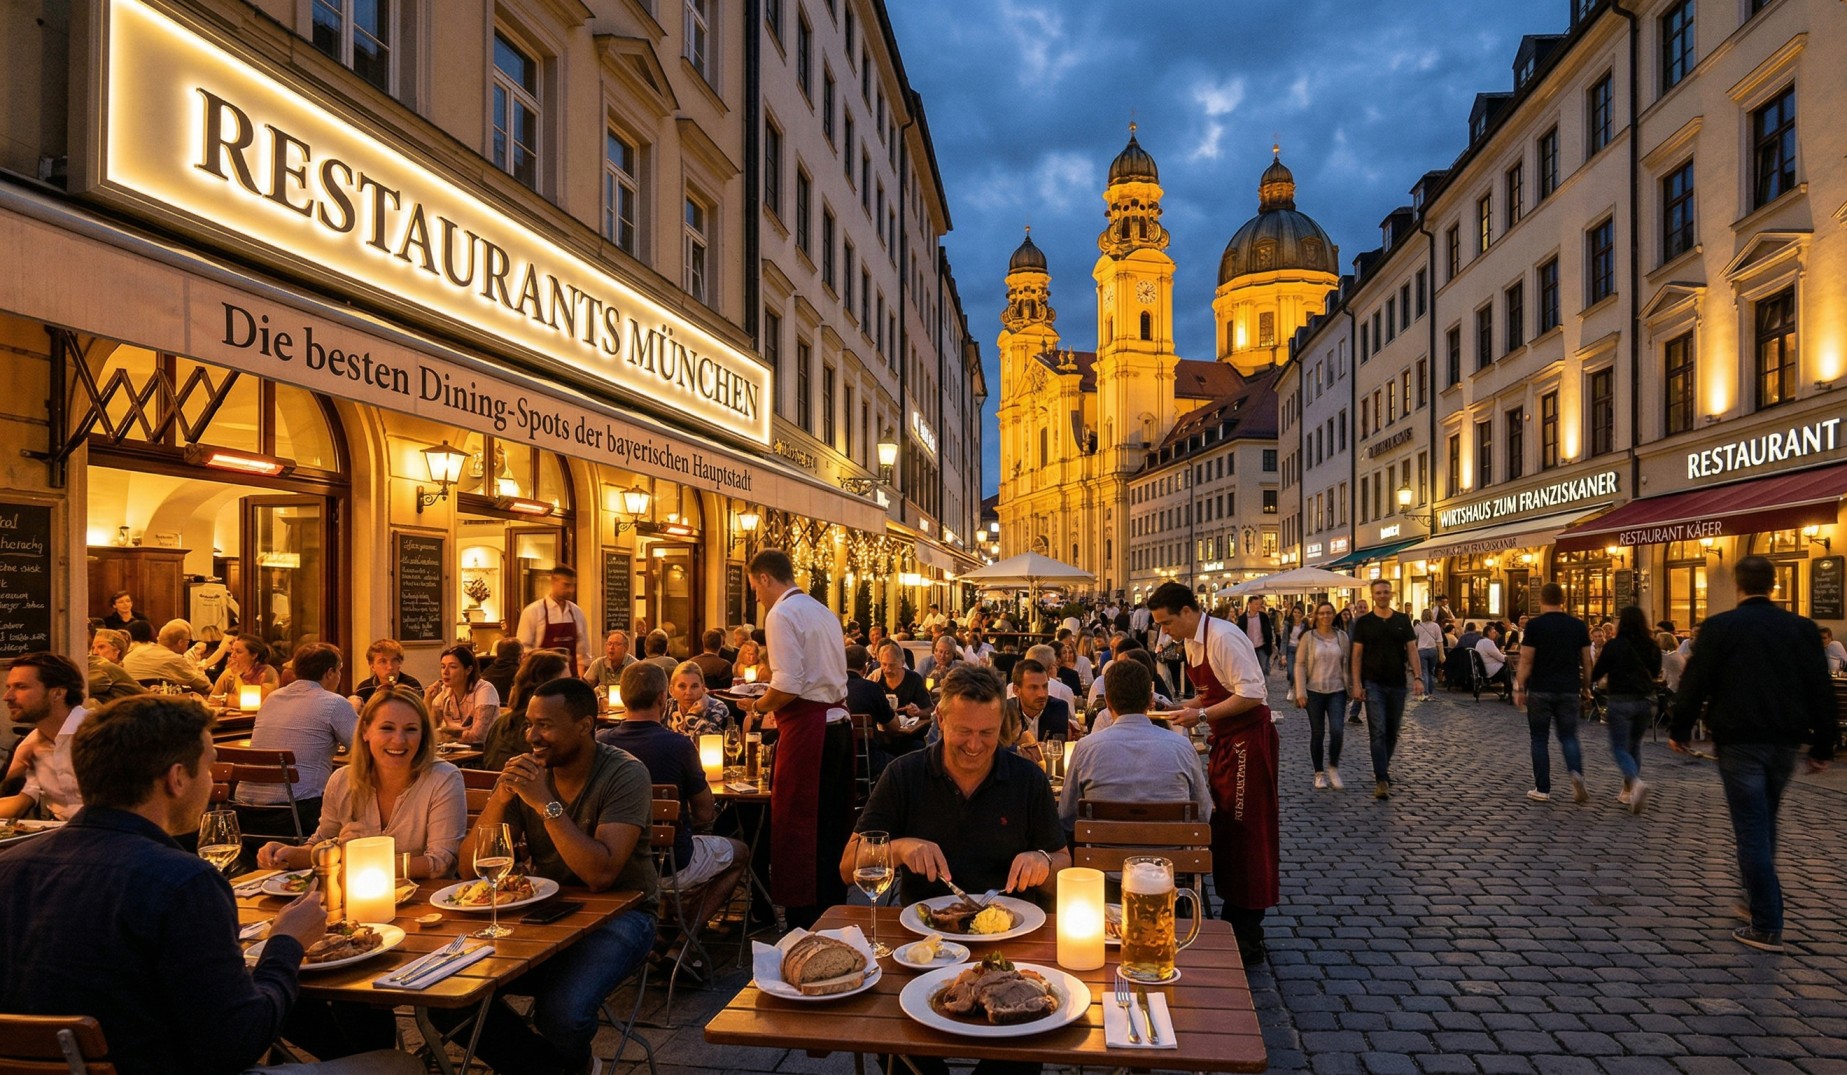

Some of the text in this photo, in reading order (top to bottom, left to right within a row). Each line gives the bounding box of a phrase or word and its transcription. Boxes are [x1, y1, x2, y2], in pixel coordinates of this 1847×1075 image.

[194, 87, 759, 420] RESTAURANTS MÜNCHEN
[221, 301, 293, 362] Die
[303, 327, 410, 395] besten
[418, 365, 570, 440] Dining-Spots
[575, 416, 603, 448] der
[607, 424, 690, 474] bayerischen
[692, 453, 752, 492] Hauptstadt
[1686, 417, 1841, 480] RESTAURANT
[1440, 471, 1617, 528] WIRTSHAUS ZUM FRANZISKANER
[1619, 520, 1722, 546] RESTAURANT KÄFER
